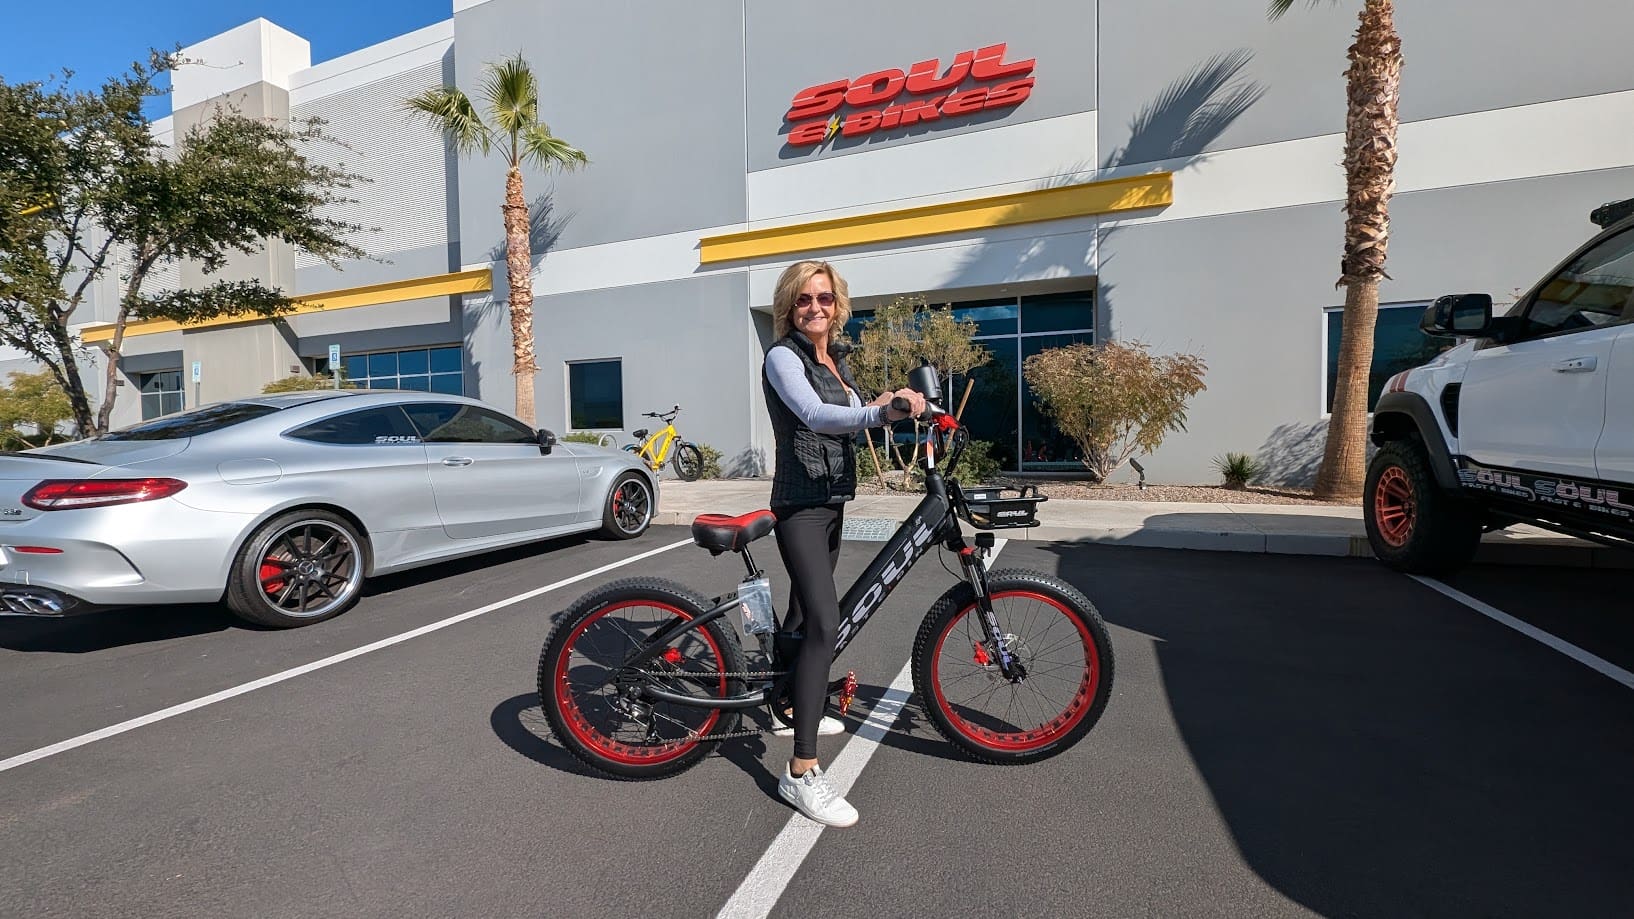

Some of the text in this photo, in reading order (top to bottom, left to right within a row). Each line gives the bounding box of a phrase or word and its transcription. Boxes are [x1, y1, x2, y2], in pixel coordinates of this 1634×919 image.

[787, 42, 1035, 121] SOUL
[788, 77, 1035, 146] E BIKES
[1457, 469, 1536, 500] SOUL
[1534, 480, 1634, 511] SOUL
